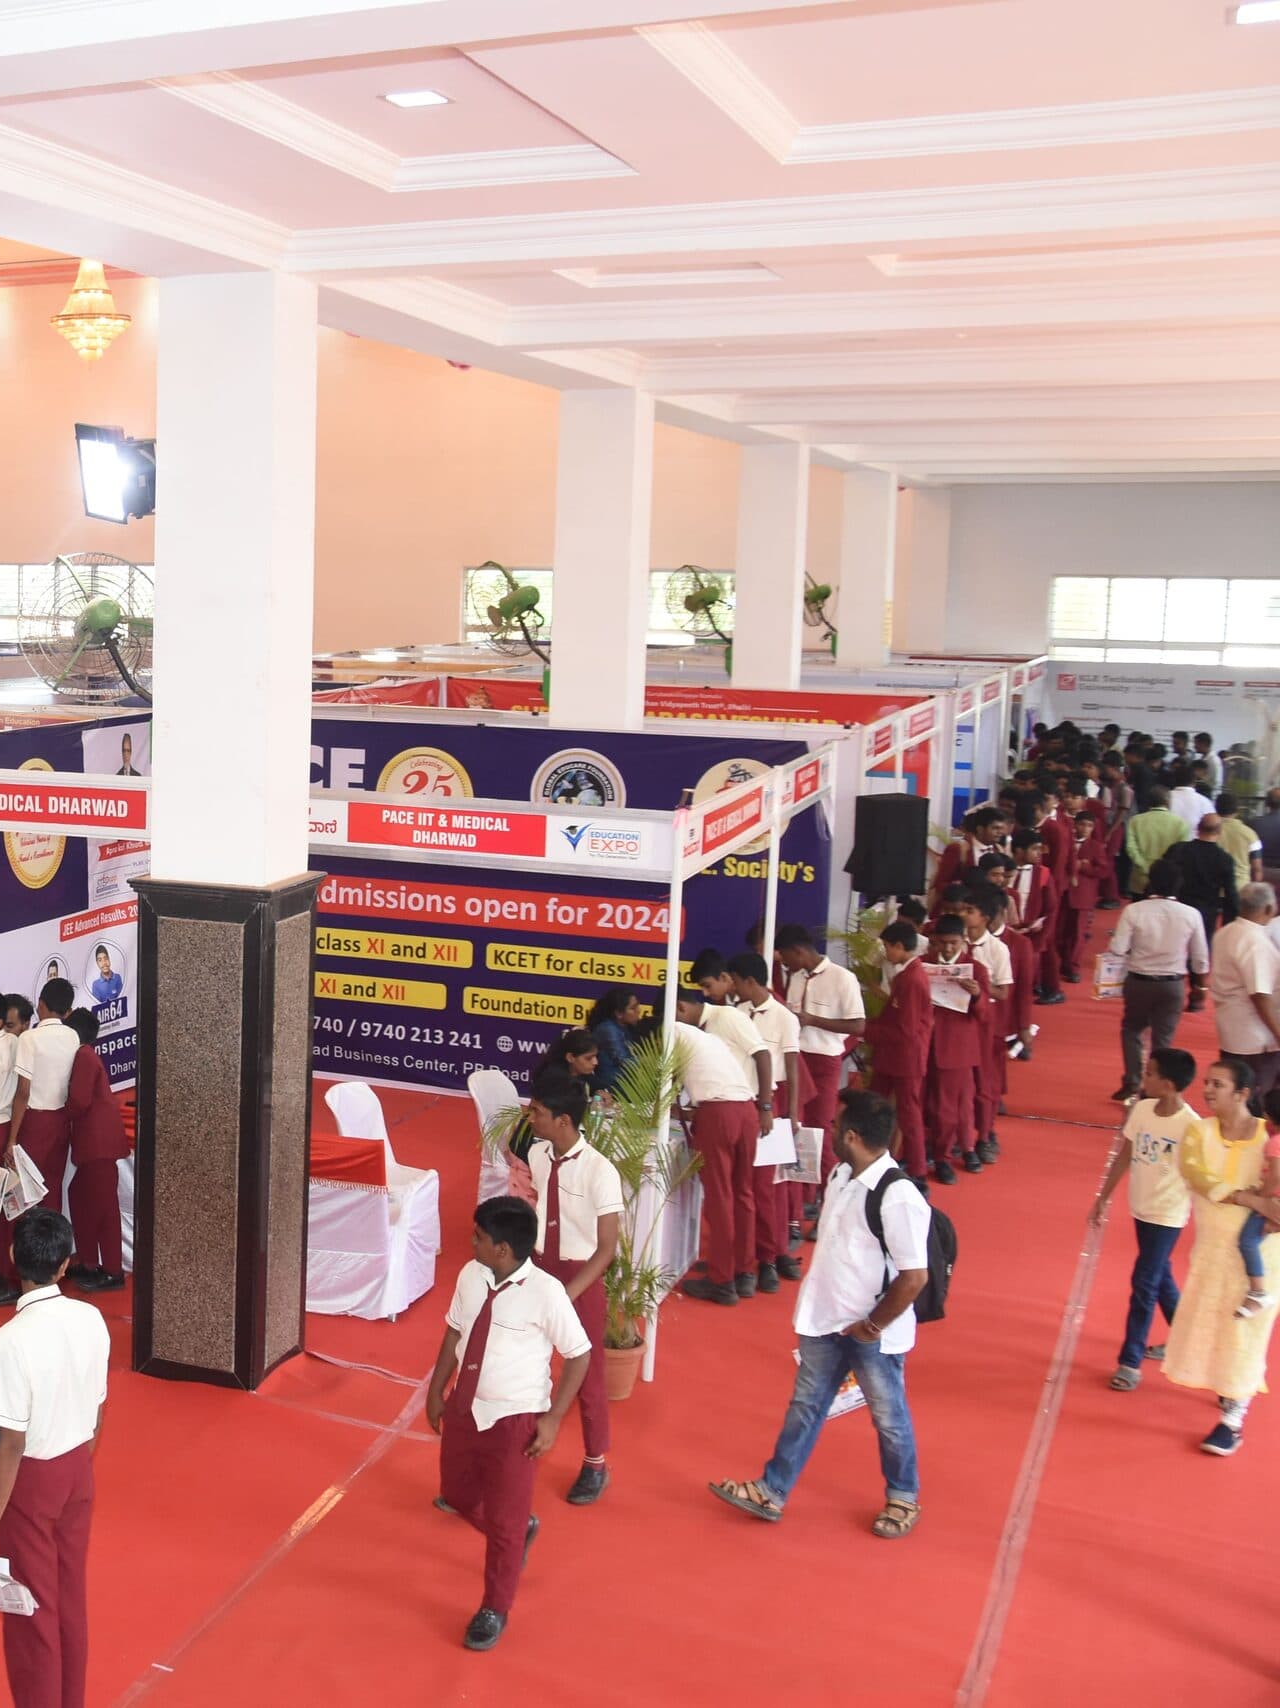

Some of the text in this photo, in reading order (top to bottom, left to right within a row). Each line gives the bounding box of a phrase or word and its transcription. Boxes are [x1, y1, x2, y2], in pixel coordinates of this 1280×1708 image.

[5, 716, 41, 726] Education
[410, 759, 444, 771] Celebrating
[402, 770, 455, 797] 25
[47, 796, 129, 818] DHARWAD
[381, 809, 511, 832] PACE IIT & MEDICAL
[412, 829, 477, 848] DHARWAD
[590, 831, 640, 841] EDUCATION
[590, 839, 639, 853] EXPO
[723, 856, 815, 884] Socity's
[317, 879, 670, 932] dmissions open for 2024
[62, 924, 74, 938] JEE
[74, 916, 100, 934] Advanced
[100, 907, 127, 926] Results
[316, 934, 458, 962] class XI and XII
[493, 949, 539, 968] KCET
[545, 953, 572, 971] for
[579, 957, 626, 978] class
[631, 962, 651, 981] XI
[320, 978, 405, 1000] XI and XII
[470, 993, 567, 1020] Foundation
[347, 1019, 357, 1037] /
[361, 1021, 406, 1041] 9740
[410, 1026, 444, 1045] 213
[449, 1031, 483, 1049] 241
[334, 1045, 399, 1067] Business
[404, 1055, 458, 1075] Center,
